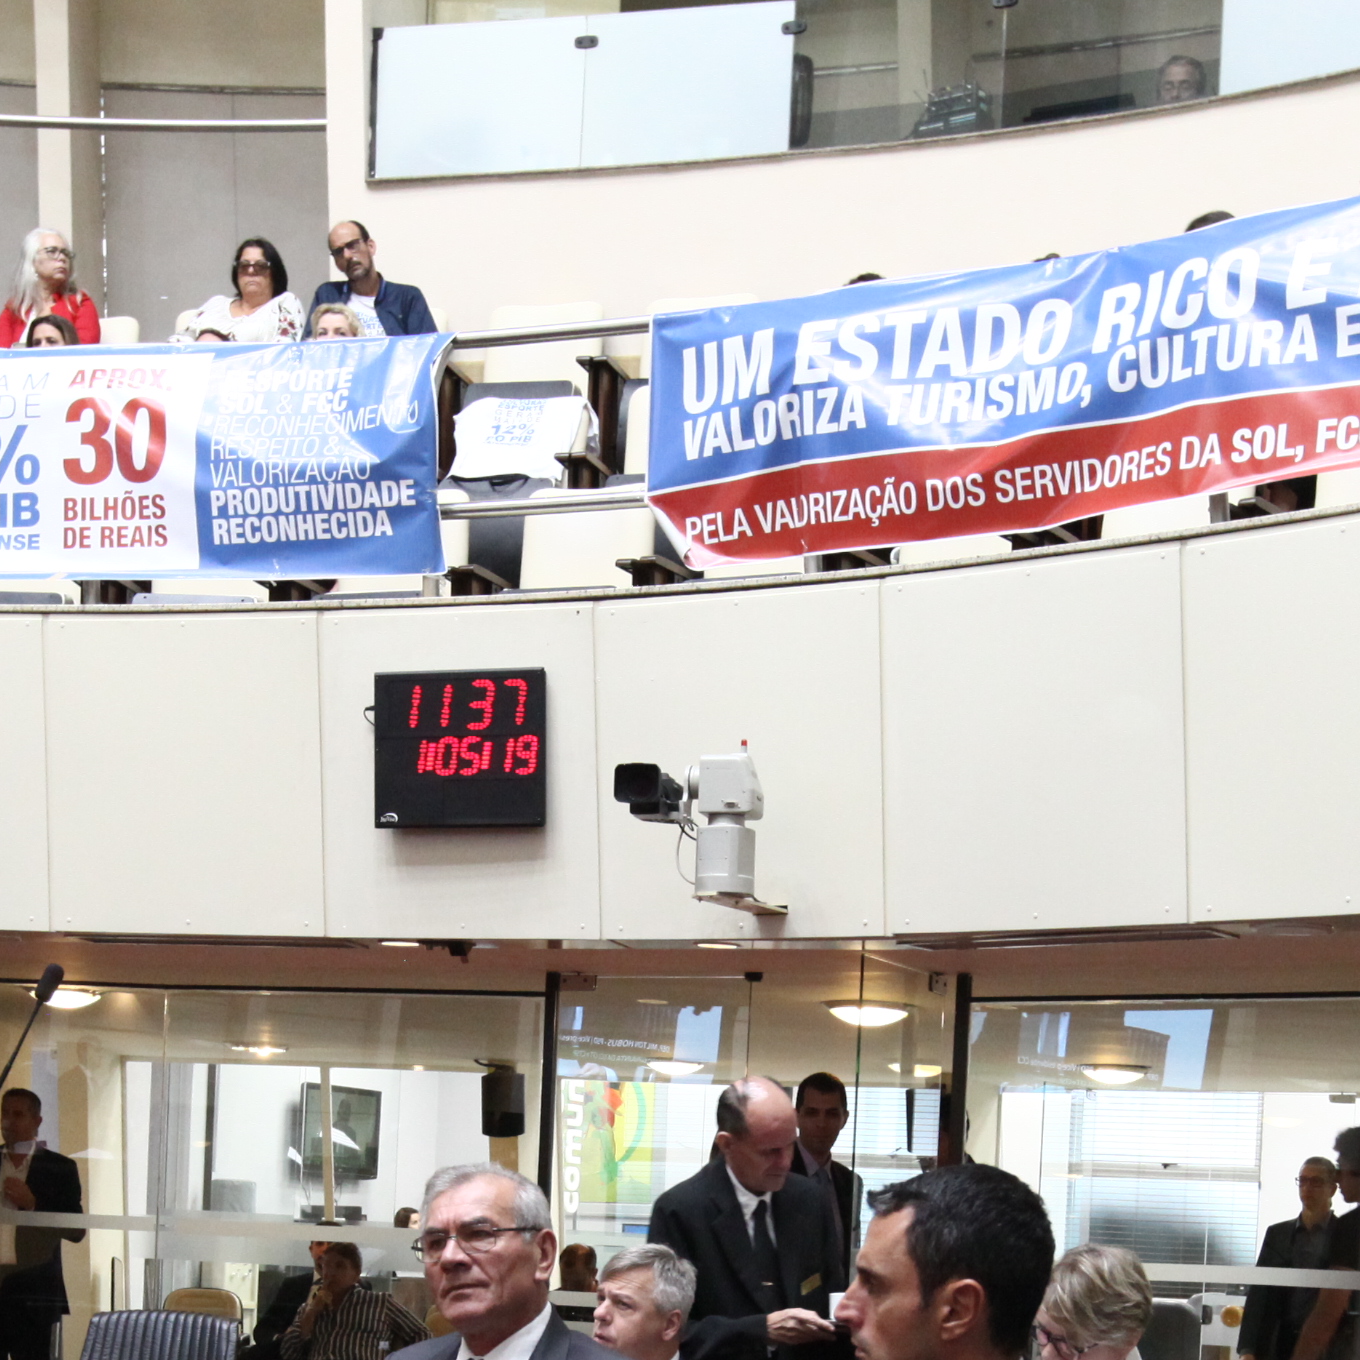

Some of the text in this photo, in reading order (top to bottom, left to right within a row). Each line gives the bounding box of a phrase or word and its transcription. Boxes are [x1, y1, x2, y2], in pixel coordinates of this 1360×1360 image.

[681, 327, 774, 415] UM
[793, 298, 1073, 386] ESTADO
[1091, 247, 1261, 354] RICO
[1285, 237, 1341, 310] E
[219, 389, 349, 414] SOL & FCC
[683, 387, 866, 461] VALORIZA
[886, 361, 1092, 428] TURISMO,
[1107, 313, 1318, 393] CULTURA
[213, 400, 418, 436] RECONHECIMENTO
[62, 397, 167, 486] 30
[211, 436, 341, 461] RESPEITO &
[210, 453, 370, 488] VALORIZAÇÃO
[686, 508, 753, 545] PELA
[926, 472, 986, 512] DOS
[995, 440, 1172, 504] SERVIDORES
[1180, 434, 1221, 470] DA
[1232, 425, 1305, 464] SOL,
[63, 490, 166, 522] BILHÕES
[210, 479, 416, 517] PRODUTIVIDADE
[63, 524, 168, 549] DE REAIS
[213, 509, 393, 545] RECONHECIDA
